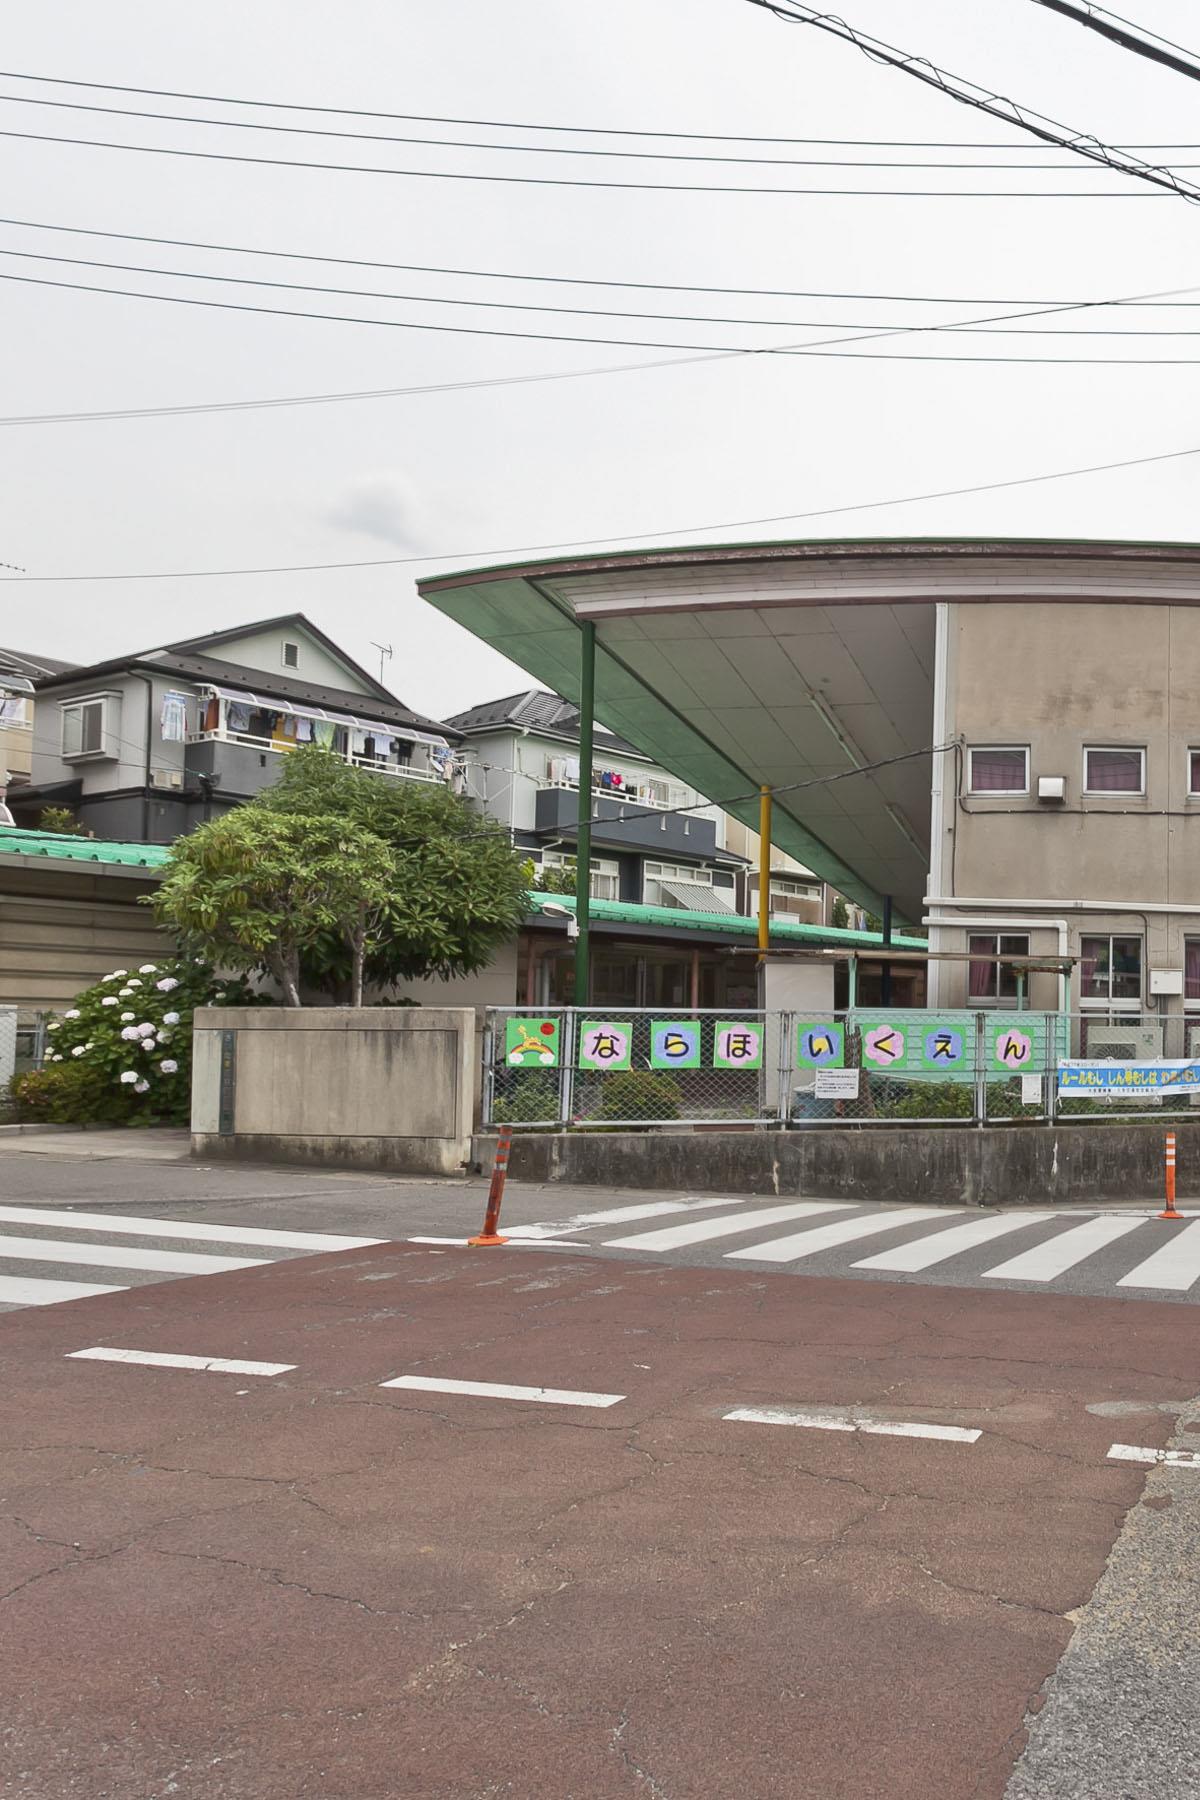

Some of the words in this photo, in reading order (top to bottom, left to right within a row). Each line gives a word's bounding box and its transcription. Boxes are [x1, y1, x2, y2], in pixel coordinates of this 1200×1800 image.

[591, 1031, 1027, 1059] ならほいくえん
